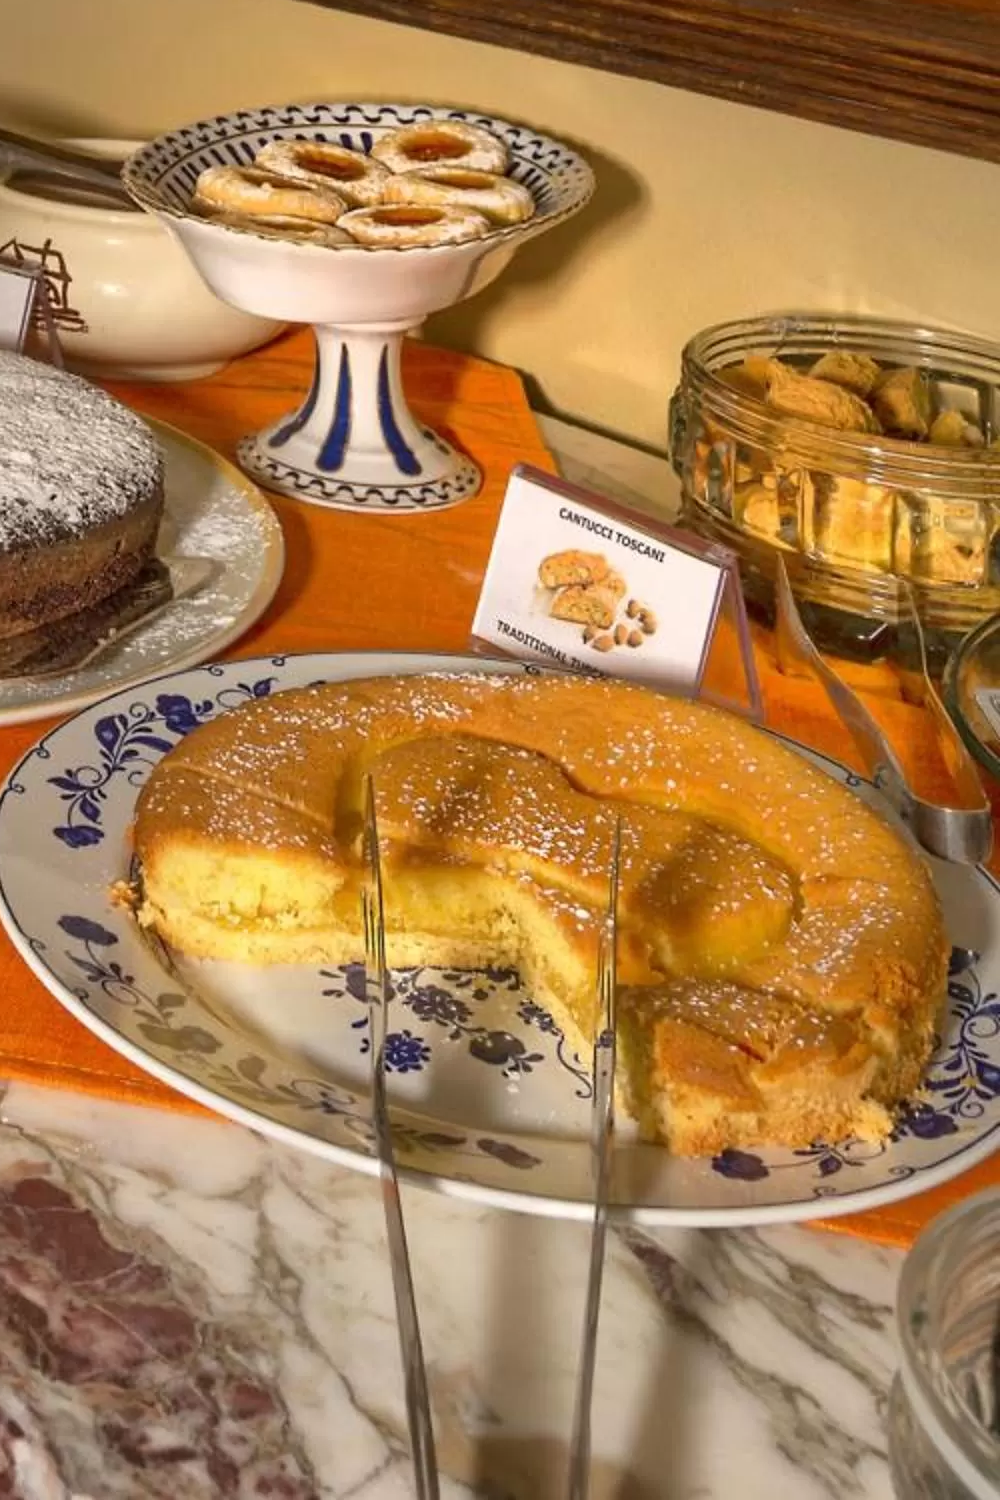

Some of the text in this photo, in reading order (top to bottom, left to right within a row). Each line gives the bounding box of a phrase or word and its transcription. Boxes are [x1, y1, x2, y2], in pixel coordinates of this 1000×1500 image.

[559, 507, 666, 563] CANTUCCI TOSCANI
[497, 619, 568, 664] TRADITIONAL
